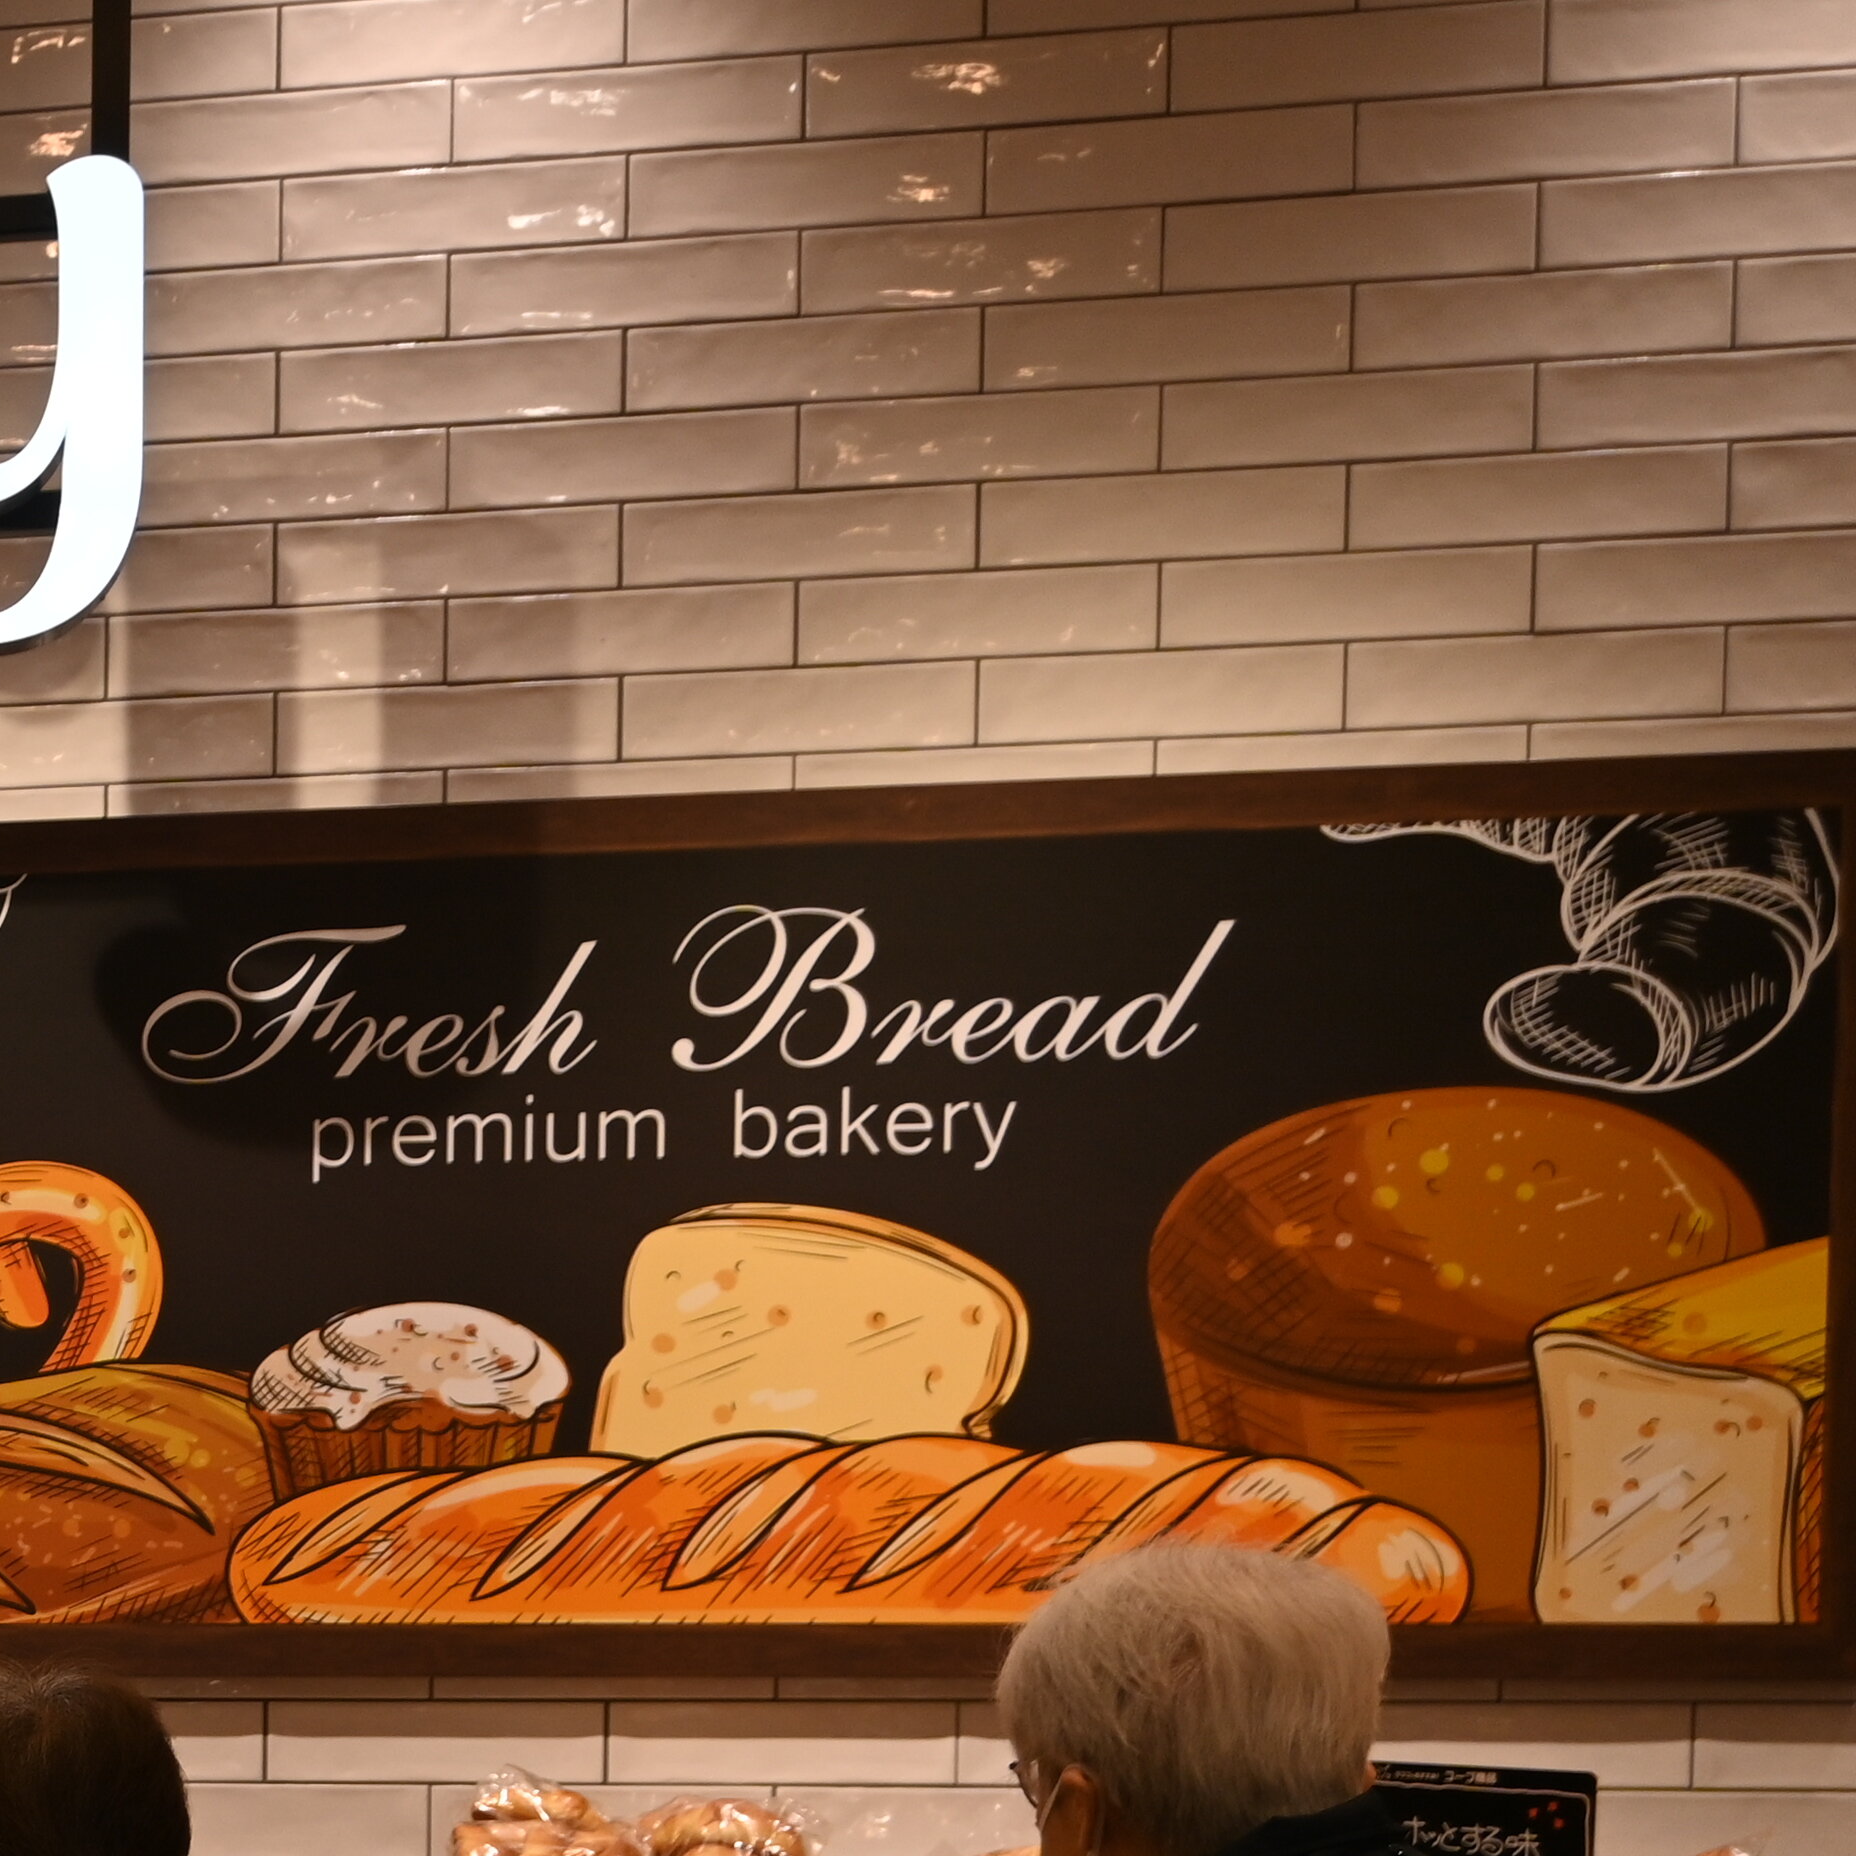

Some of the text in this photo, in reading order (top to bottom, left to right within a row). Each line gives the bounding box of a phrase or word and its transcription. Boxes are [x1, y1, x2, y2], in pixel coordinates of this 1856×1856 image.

[140, 902, 1236, 1086] Fresh Bread
[310, 1088, 1018, 1184] premium bakery
